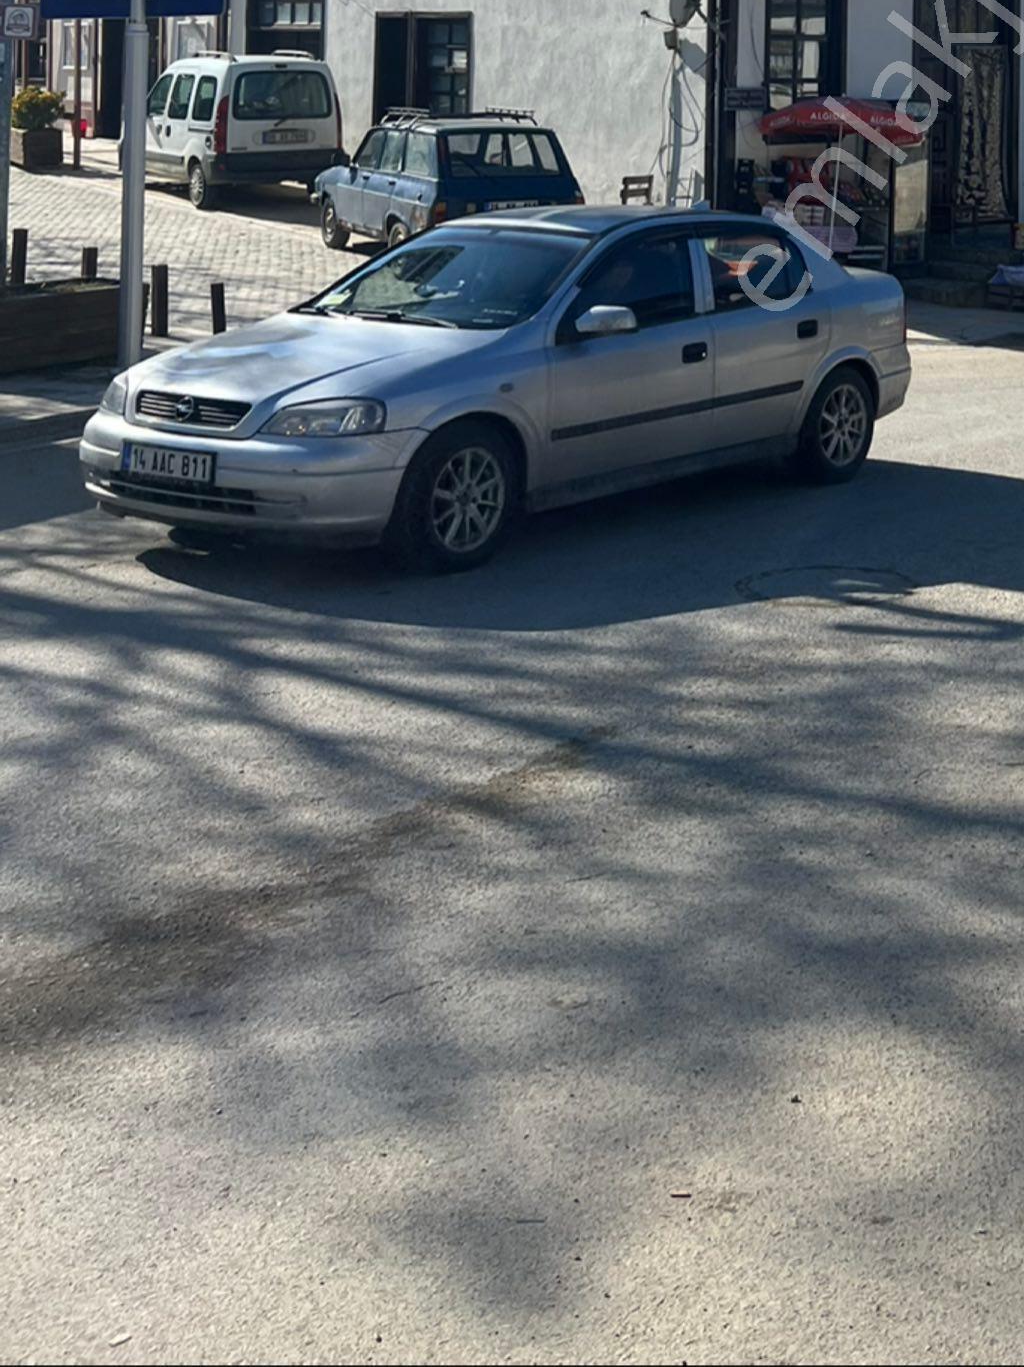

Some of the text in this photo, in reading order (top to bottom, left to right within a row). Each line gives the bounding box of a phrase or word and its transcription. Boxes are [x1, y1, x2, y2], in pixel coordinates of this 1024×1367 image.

[134, 448, 207, 479] 14 AAC 811
